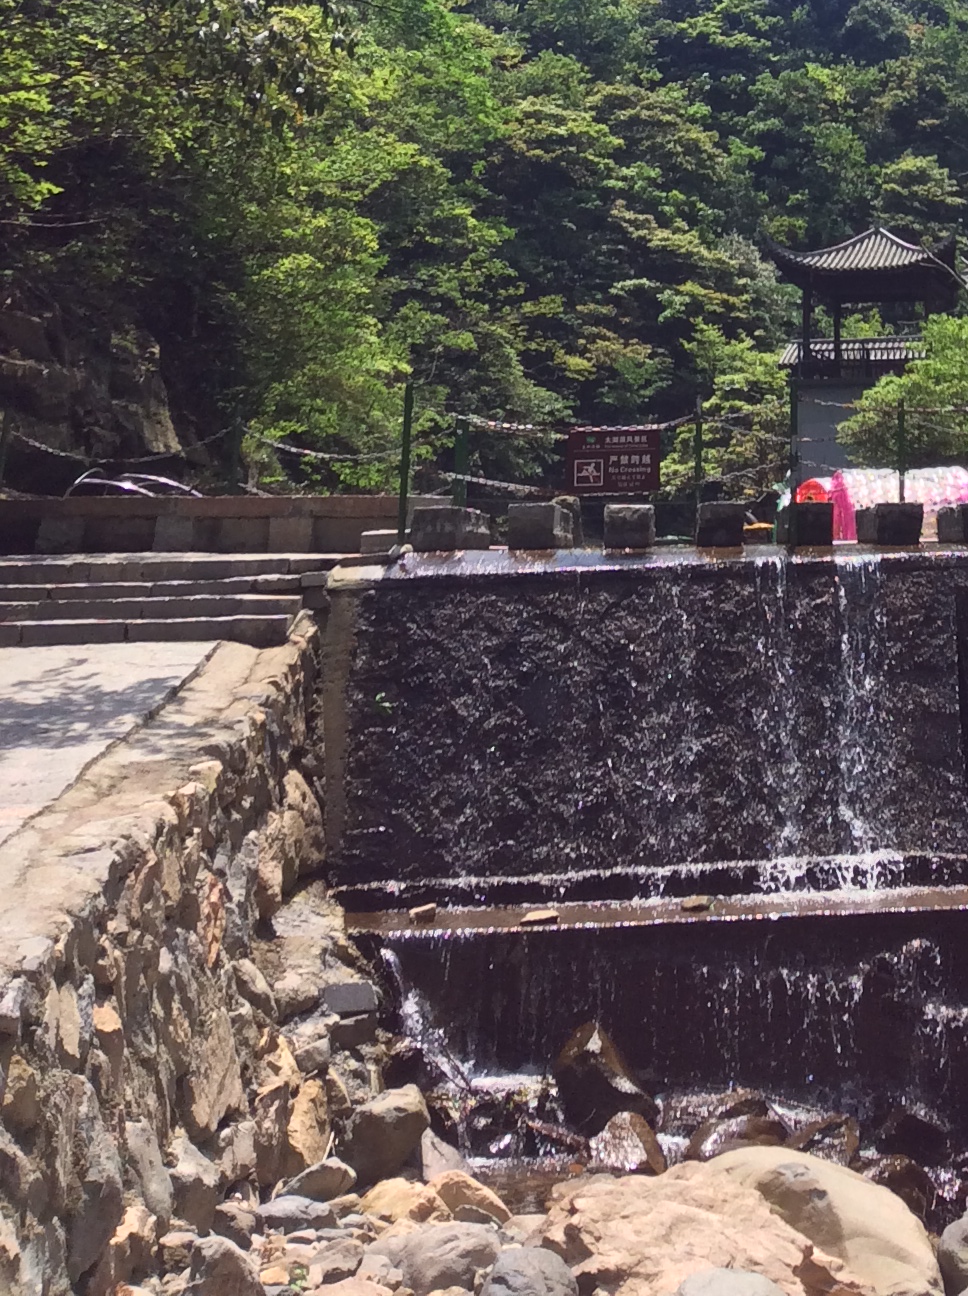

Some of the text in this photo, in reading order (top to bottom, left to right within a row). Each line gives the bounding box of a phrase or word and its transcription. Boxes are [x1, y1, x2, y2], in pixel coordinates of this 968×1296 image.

[609, 454, 651, 465] 严禁跨越
[620, 466, 651, 474] Crossing
